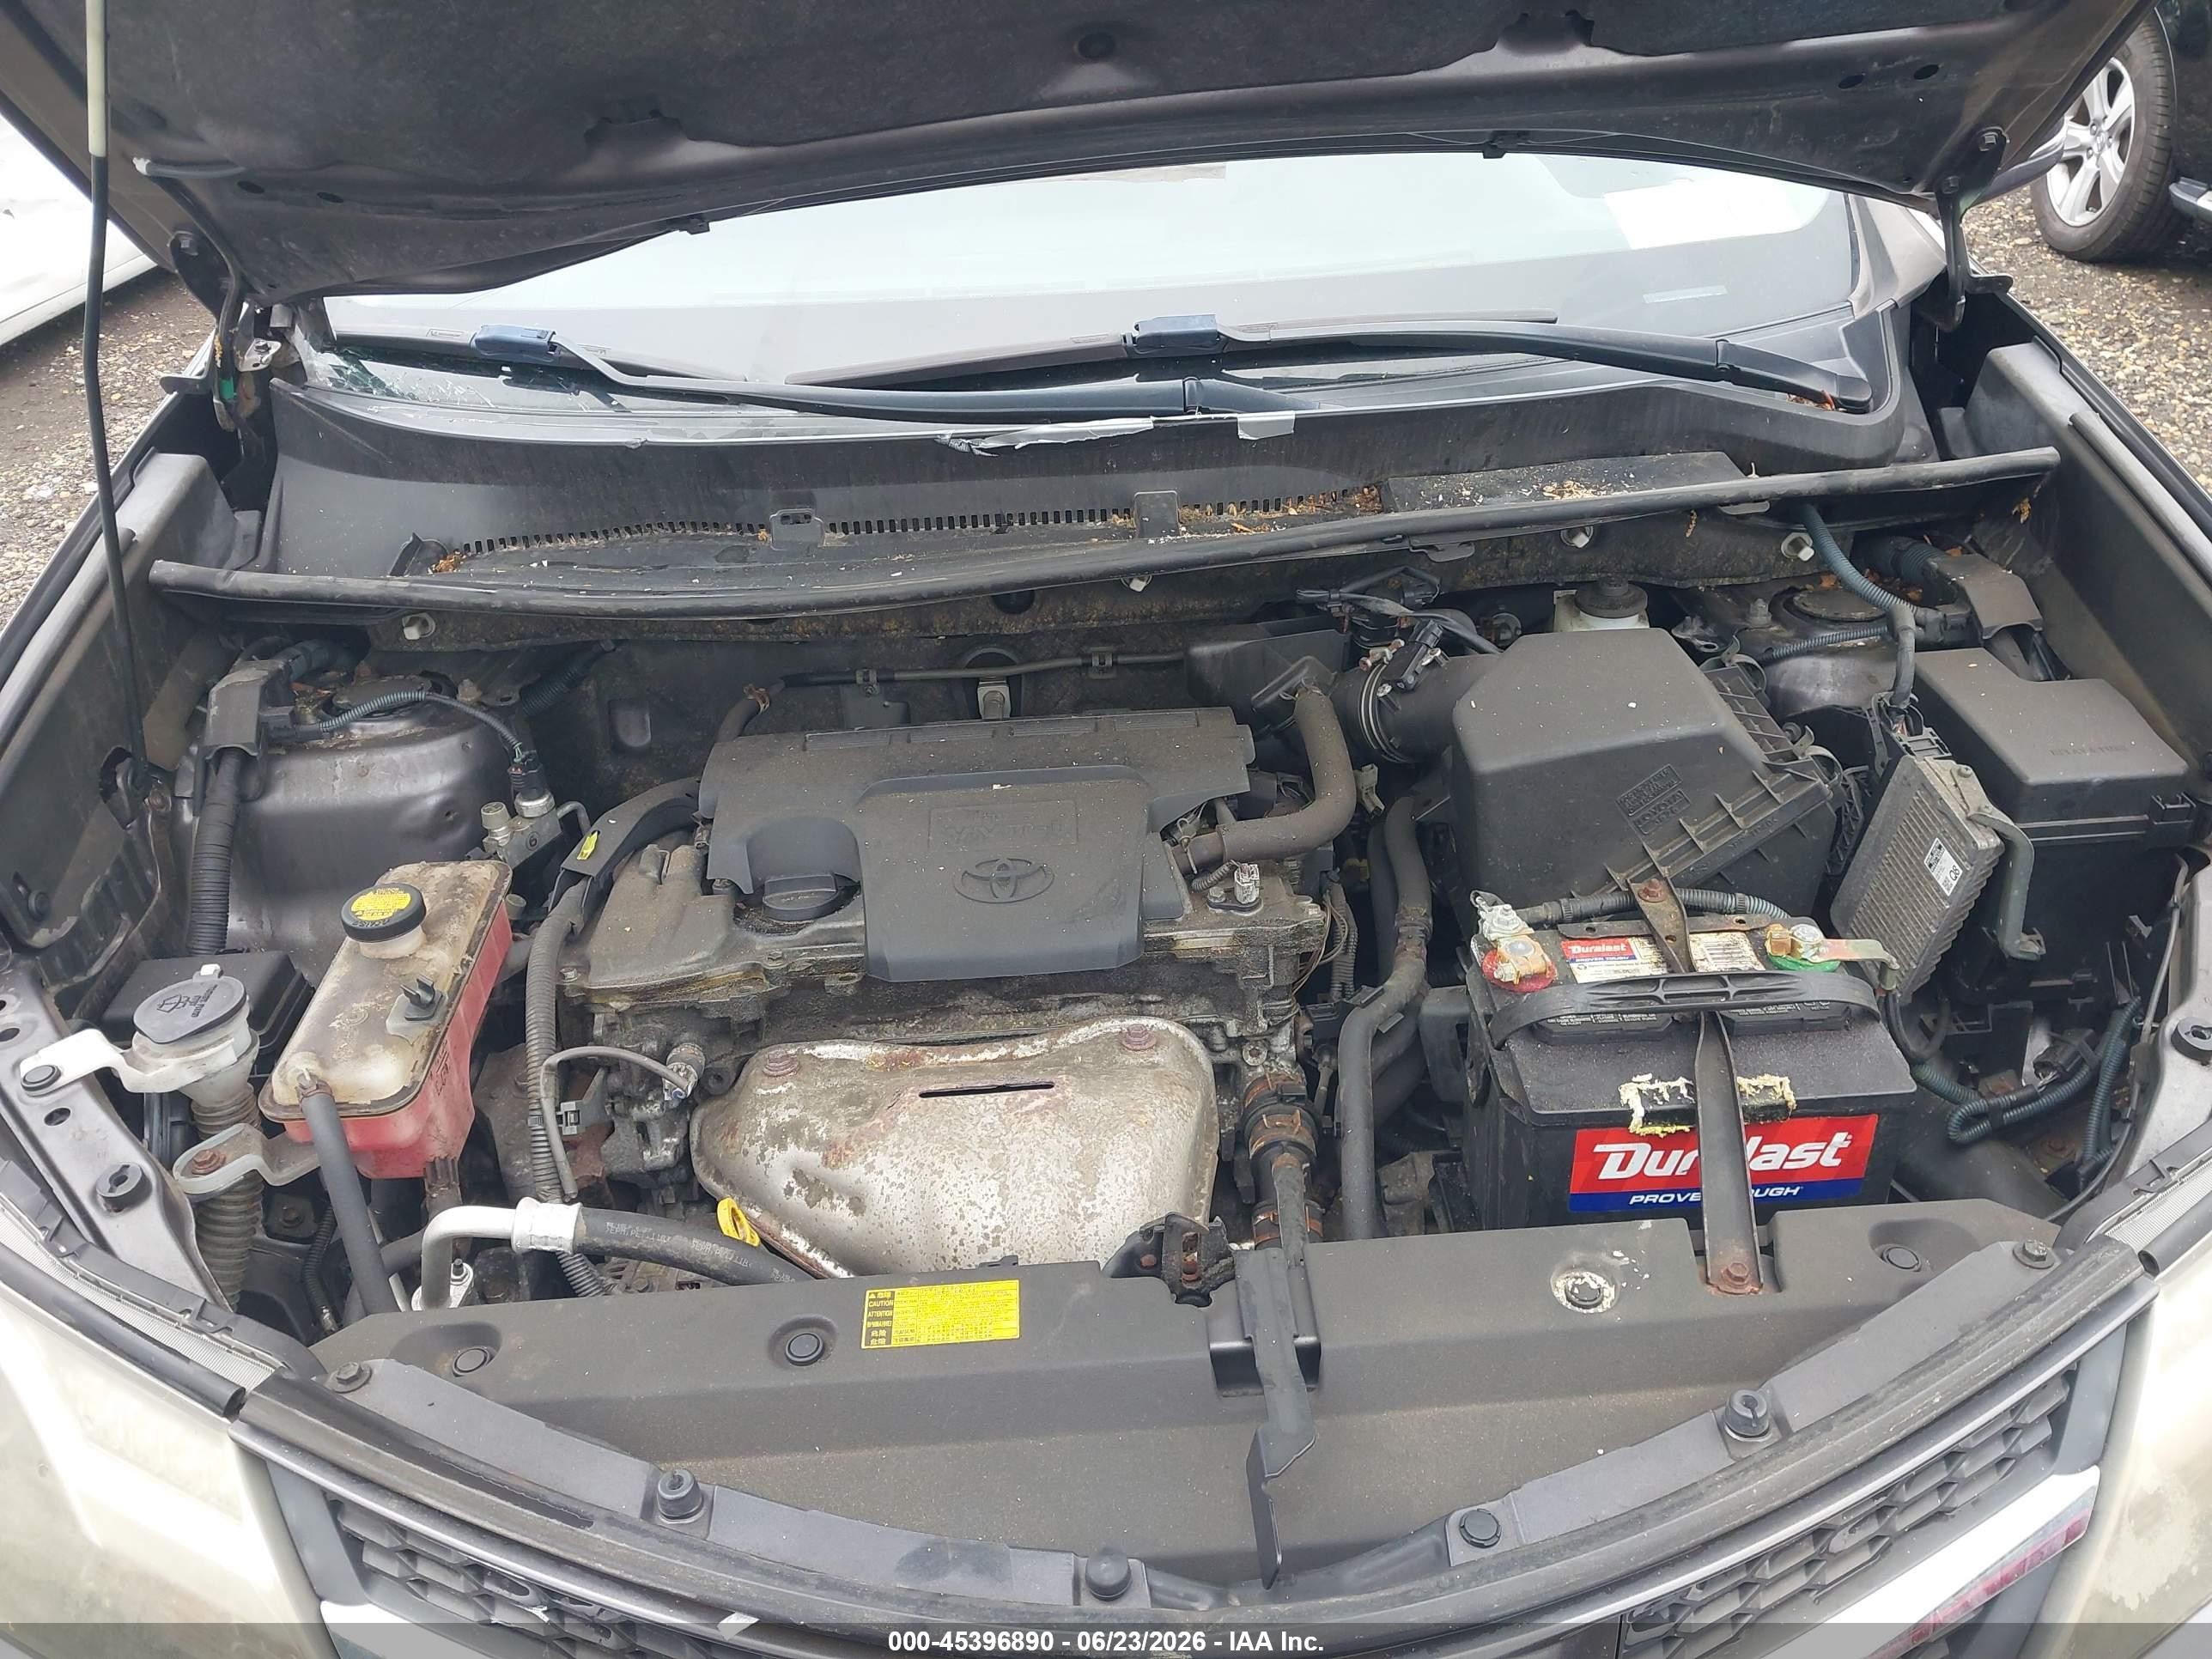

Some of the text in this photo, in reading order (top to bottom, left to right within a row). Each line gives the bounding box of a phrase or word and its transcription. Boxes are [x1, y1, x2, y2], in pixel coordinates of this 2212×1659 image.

[1567, 943, 1627, 954] Duralast
[1593, 1131, 1852, 1180] Durlast
[1629, 1191, 1702, 1206] PROVE
[868, 1299, 894, 1308] CAUTION
